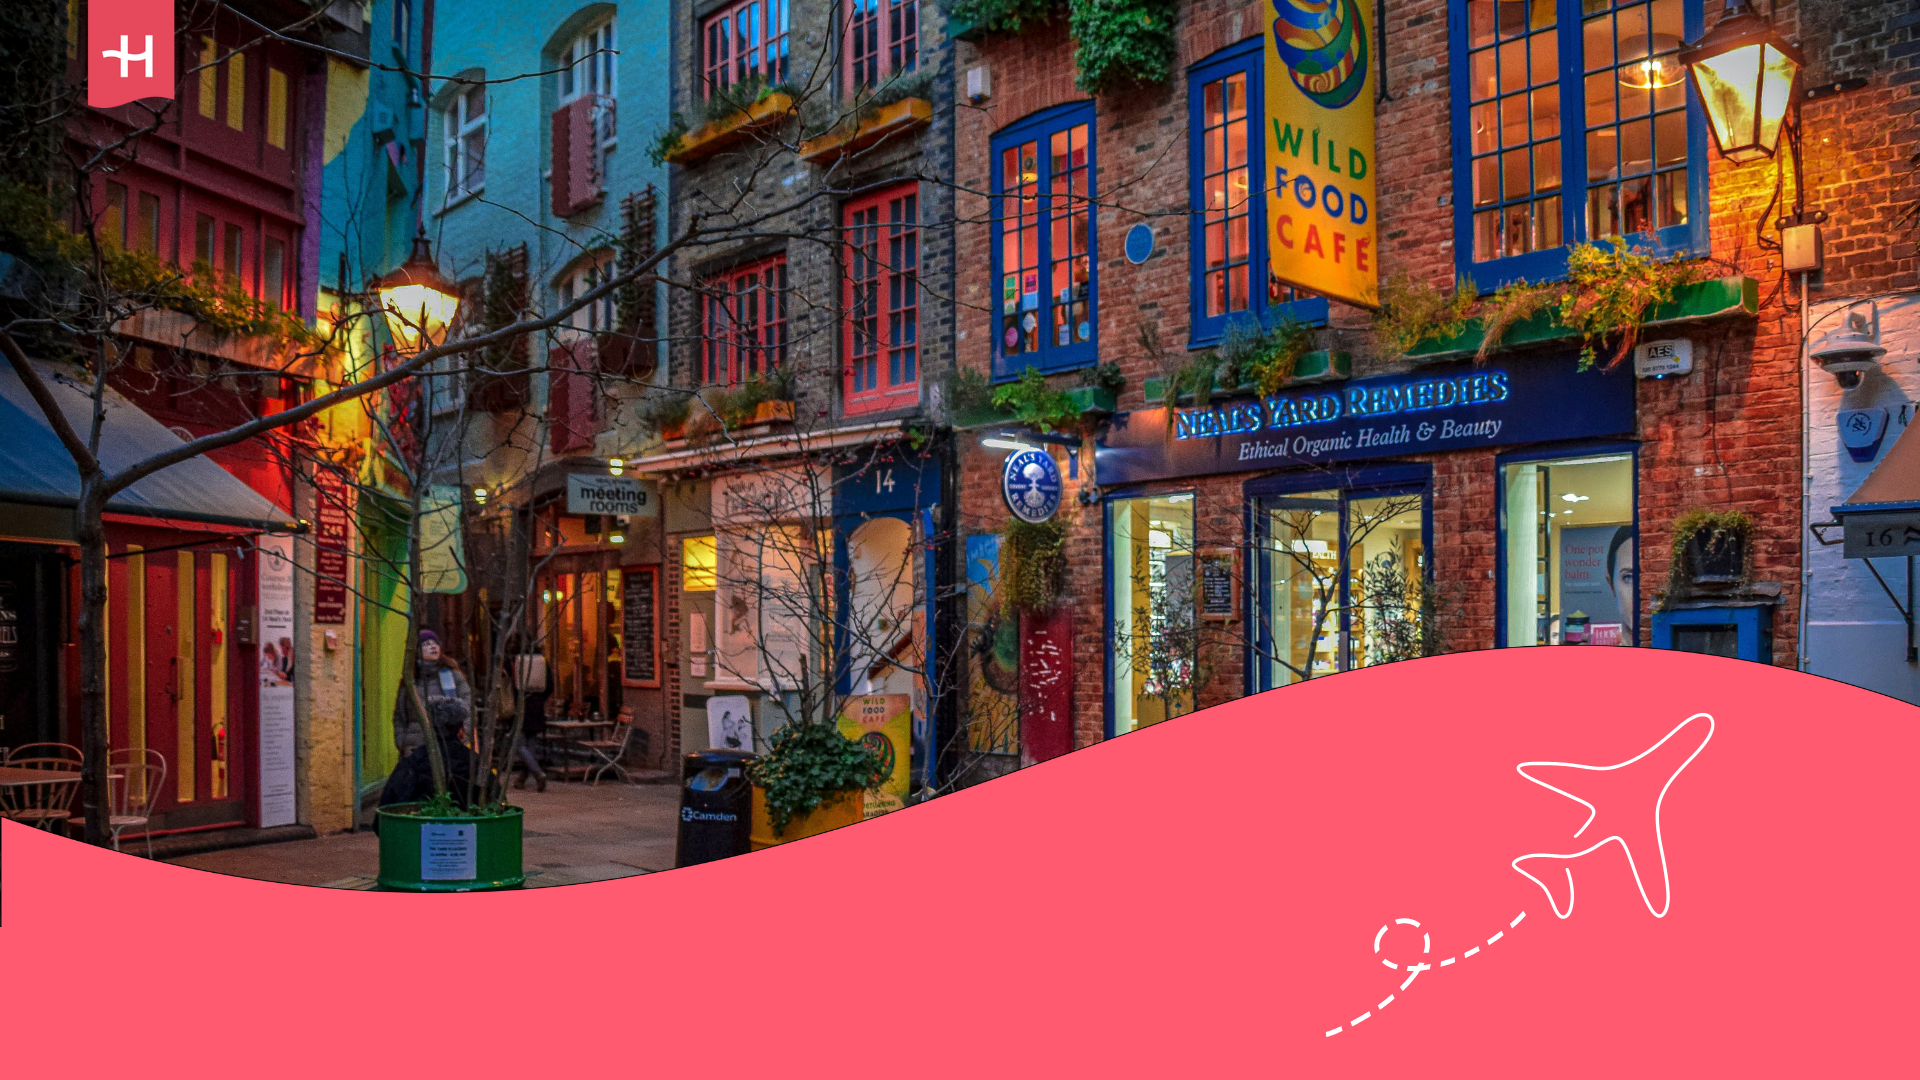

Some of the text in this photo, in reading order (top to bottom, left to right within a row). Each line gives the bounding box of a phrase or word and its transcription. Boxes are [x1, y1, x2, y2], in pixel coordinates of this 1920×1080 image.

[1273, 117, 1367, 180] WILD
[1275, 165, 1368, 225] FOOD
[1648, 345, 1673, 358] AES
[1264, 394, 1341, 430] YARD
[1342, 371, 1508, 418] REMEDIES
[1238, 419, 1502, 461] Ethical Organic Health & Beauty
[876, 469, 896, 494] 14
[581, 486, 647, 506] meeting
[590, 500, 638, 514] rooms
[1865, 529, 1893, 547] 16
[1564, 543, 1605, 556] One pot
[1564, 557, 1602, 568] wonder
[1564, 569, 1590, 580] balm
[693, 811, 737, 821] Camden
